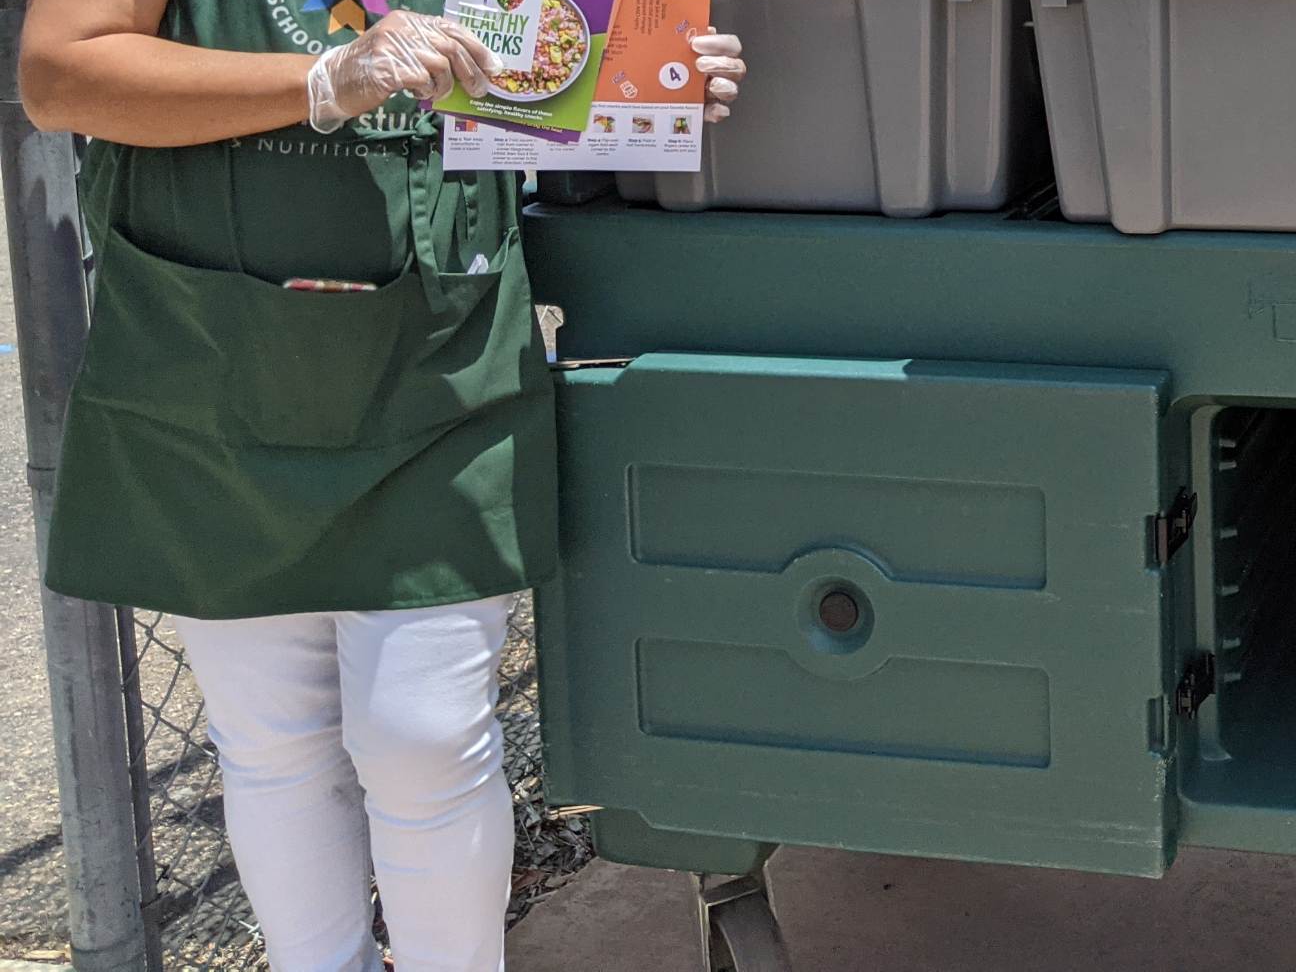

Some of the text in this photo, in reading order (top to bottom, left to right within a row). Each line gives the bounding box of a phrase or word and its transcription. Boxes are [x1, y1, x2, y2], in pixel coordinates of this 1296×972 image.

[459, 6, 530, 35] HEALTHY
[472, 30, 523, 55] ACKS
[669, 66, 681, 81] 4
[495, 103, 512, 111] simple
